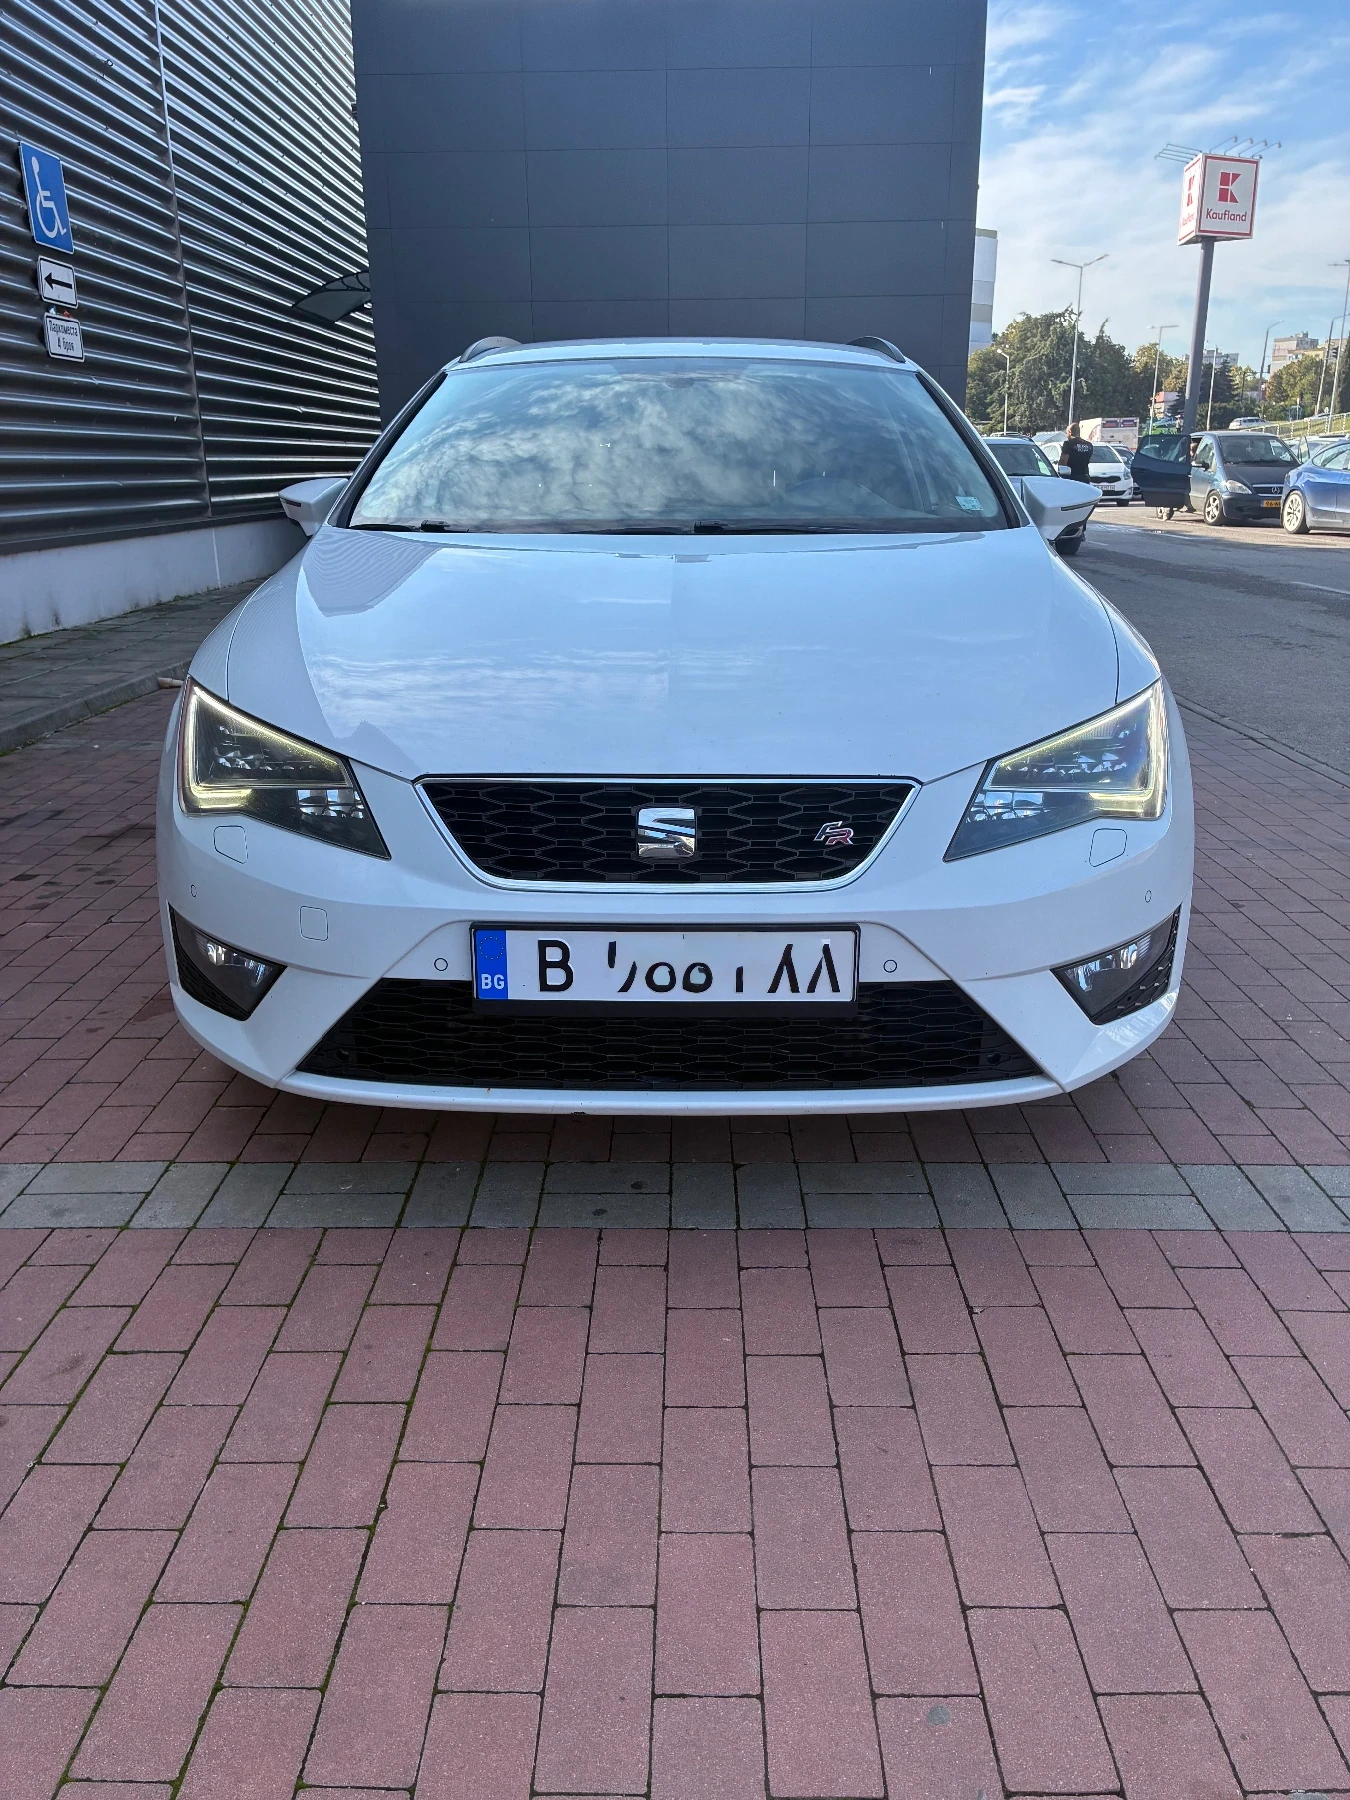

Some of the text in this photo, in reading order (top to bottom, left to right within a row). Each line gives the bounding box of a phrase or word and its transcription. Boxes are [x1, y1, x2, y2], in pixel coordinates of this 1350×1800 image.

[1206, 208, 1248, 222] Kaufland
[814, 820, 854, 845] FR
[480, 973, 505, 989] BG
